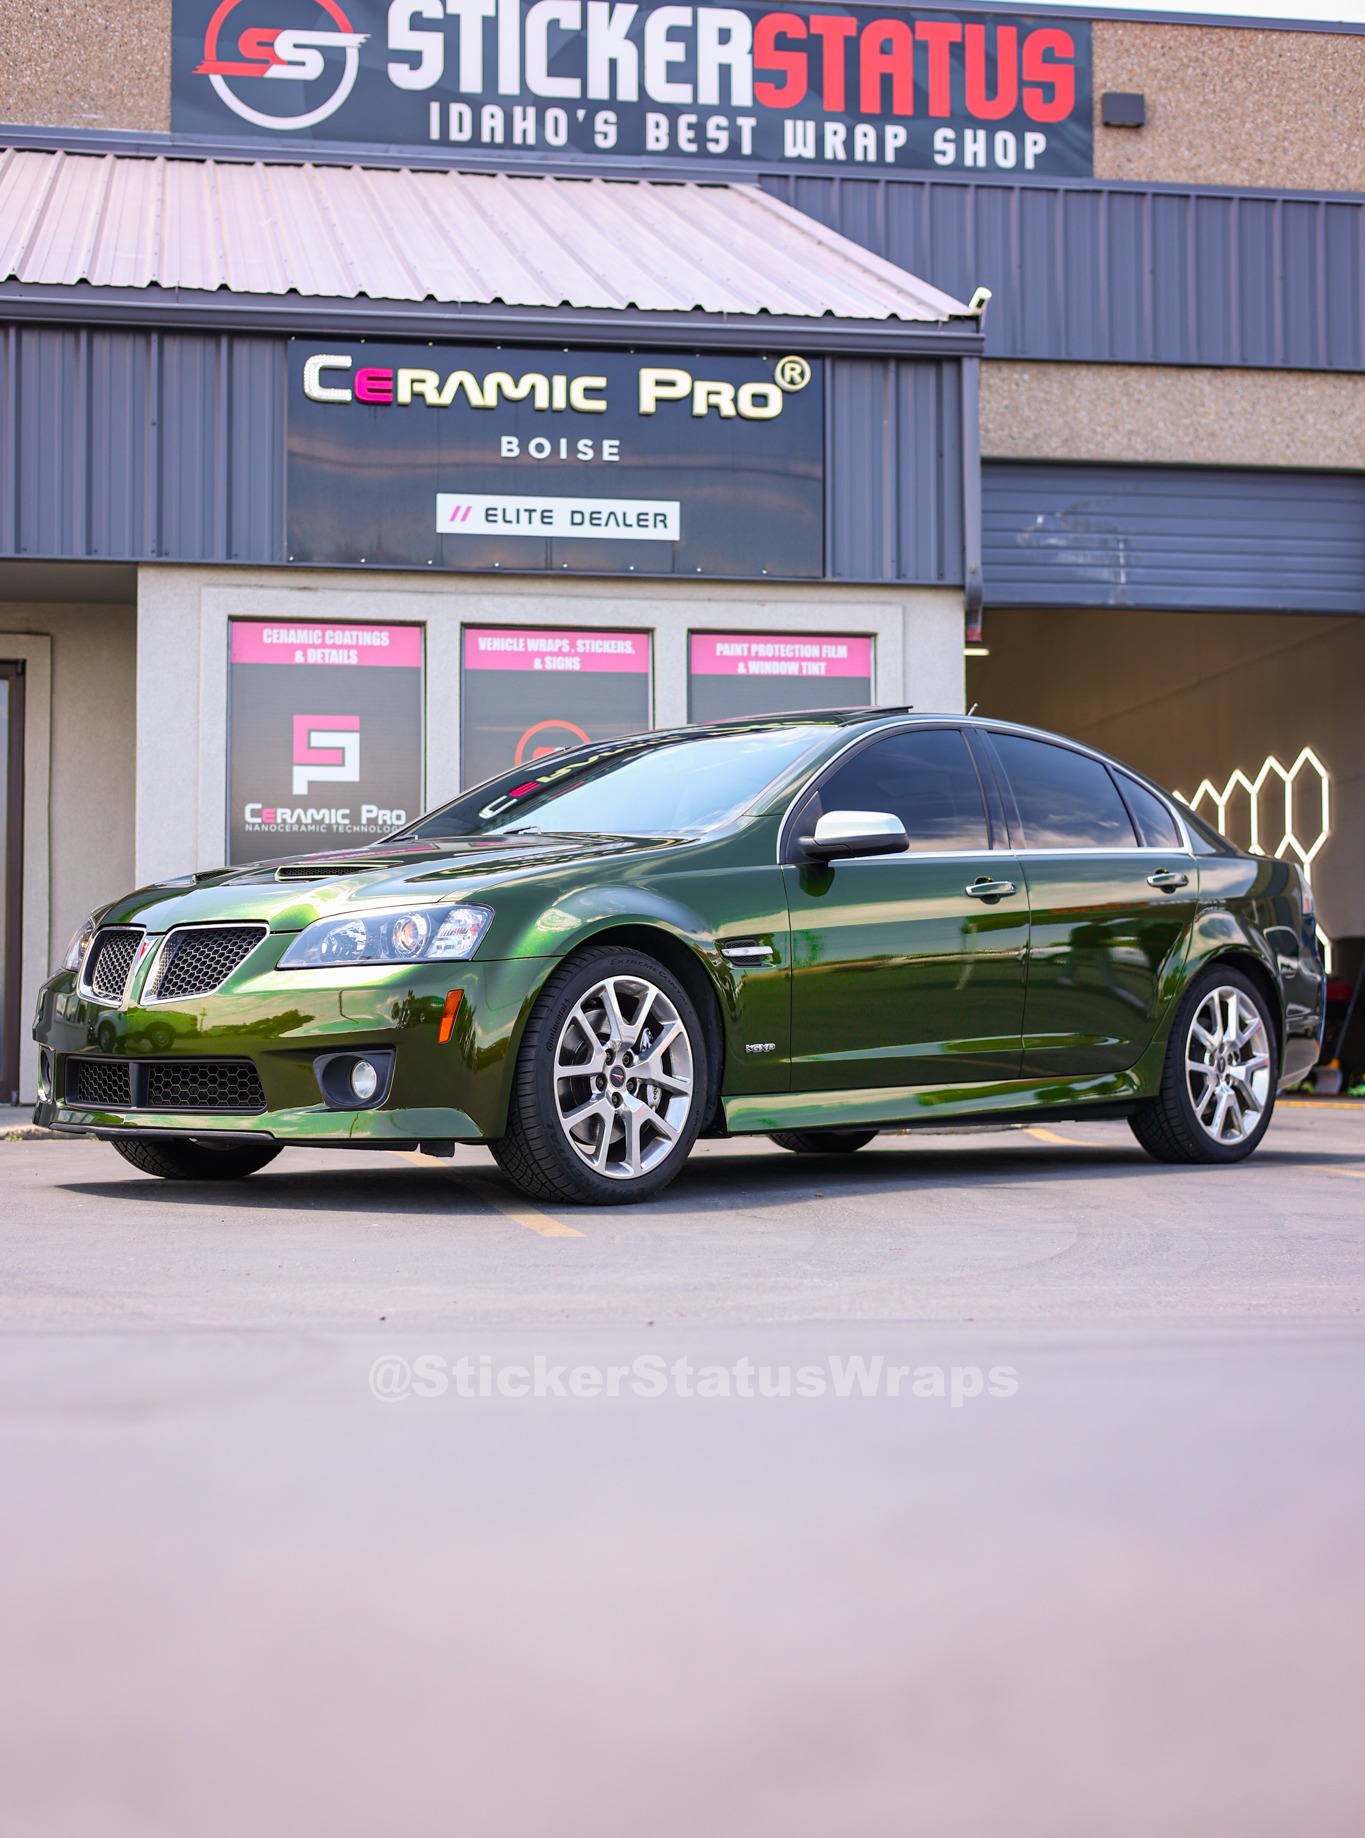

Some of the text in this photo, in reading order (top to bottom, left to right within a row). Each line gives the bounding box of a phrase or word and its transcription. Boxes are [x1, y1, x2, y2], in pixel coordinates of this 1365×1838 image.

[429, 101, 1047, 170] IDAHO'S BEST WRAP SHOP
[303, 354, 608, 413] CERAMIC
[500, 435, 621, 461] BOISE
[484, 506, 554, 525] ELITE
[570, 509, 668, 529] DEALER
[263, 628, 390, 646] CERAMIC COATINGS
[478, 637, 525, 651] VEHICLE
[576, 639, 635, 655] STICKERS,
[294, 648, 358, 665] & DETAILS
[715, 642, 848, 659] PAINT PROTECTION FILM
[533, 656, 581, 671] & SIGNS
[737, 661, 827, 675] & WINDOW TINT
[244, 803, 406, 825] CERAMIC PRO
[245, 823, 327, 832] NANOCERAMIC
